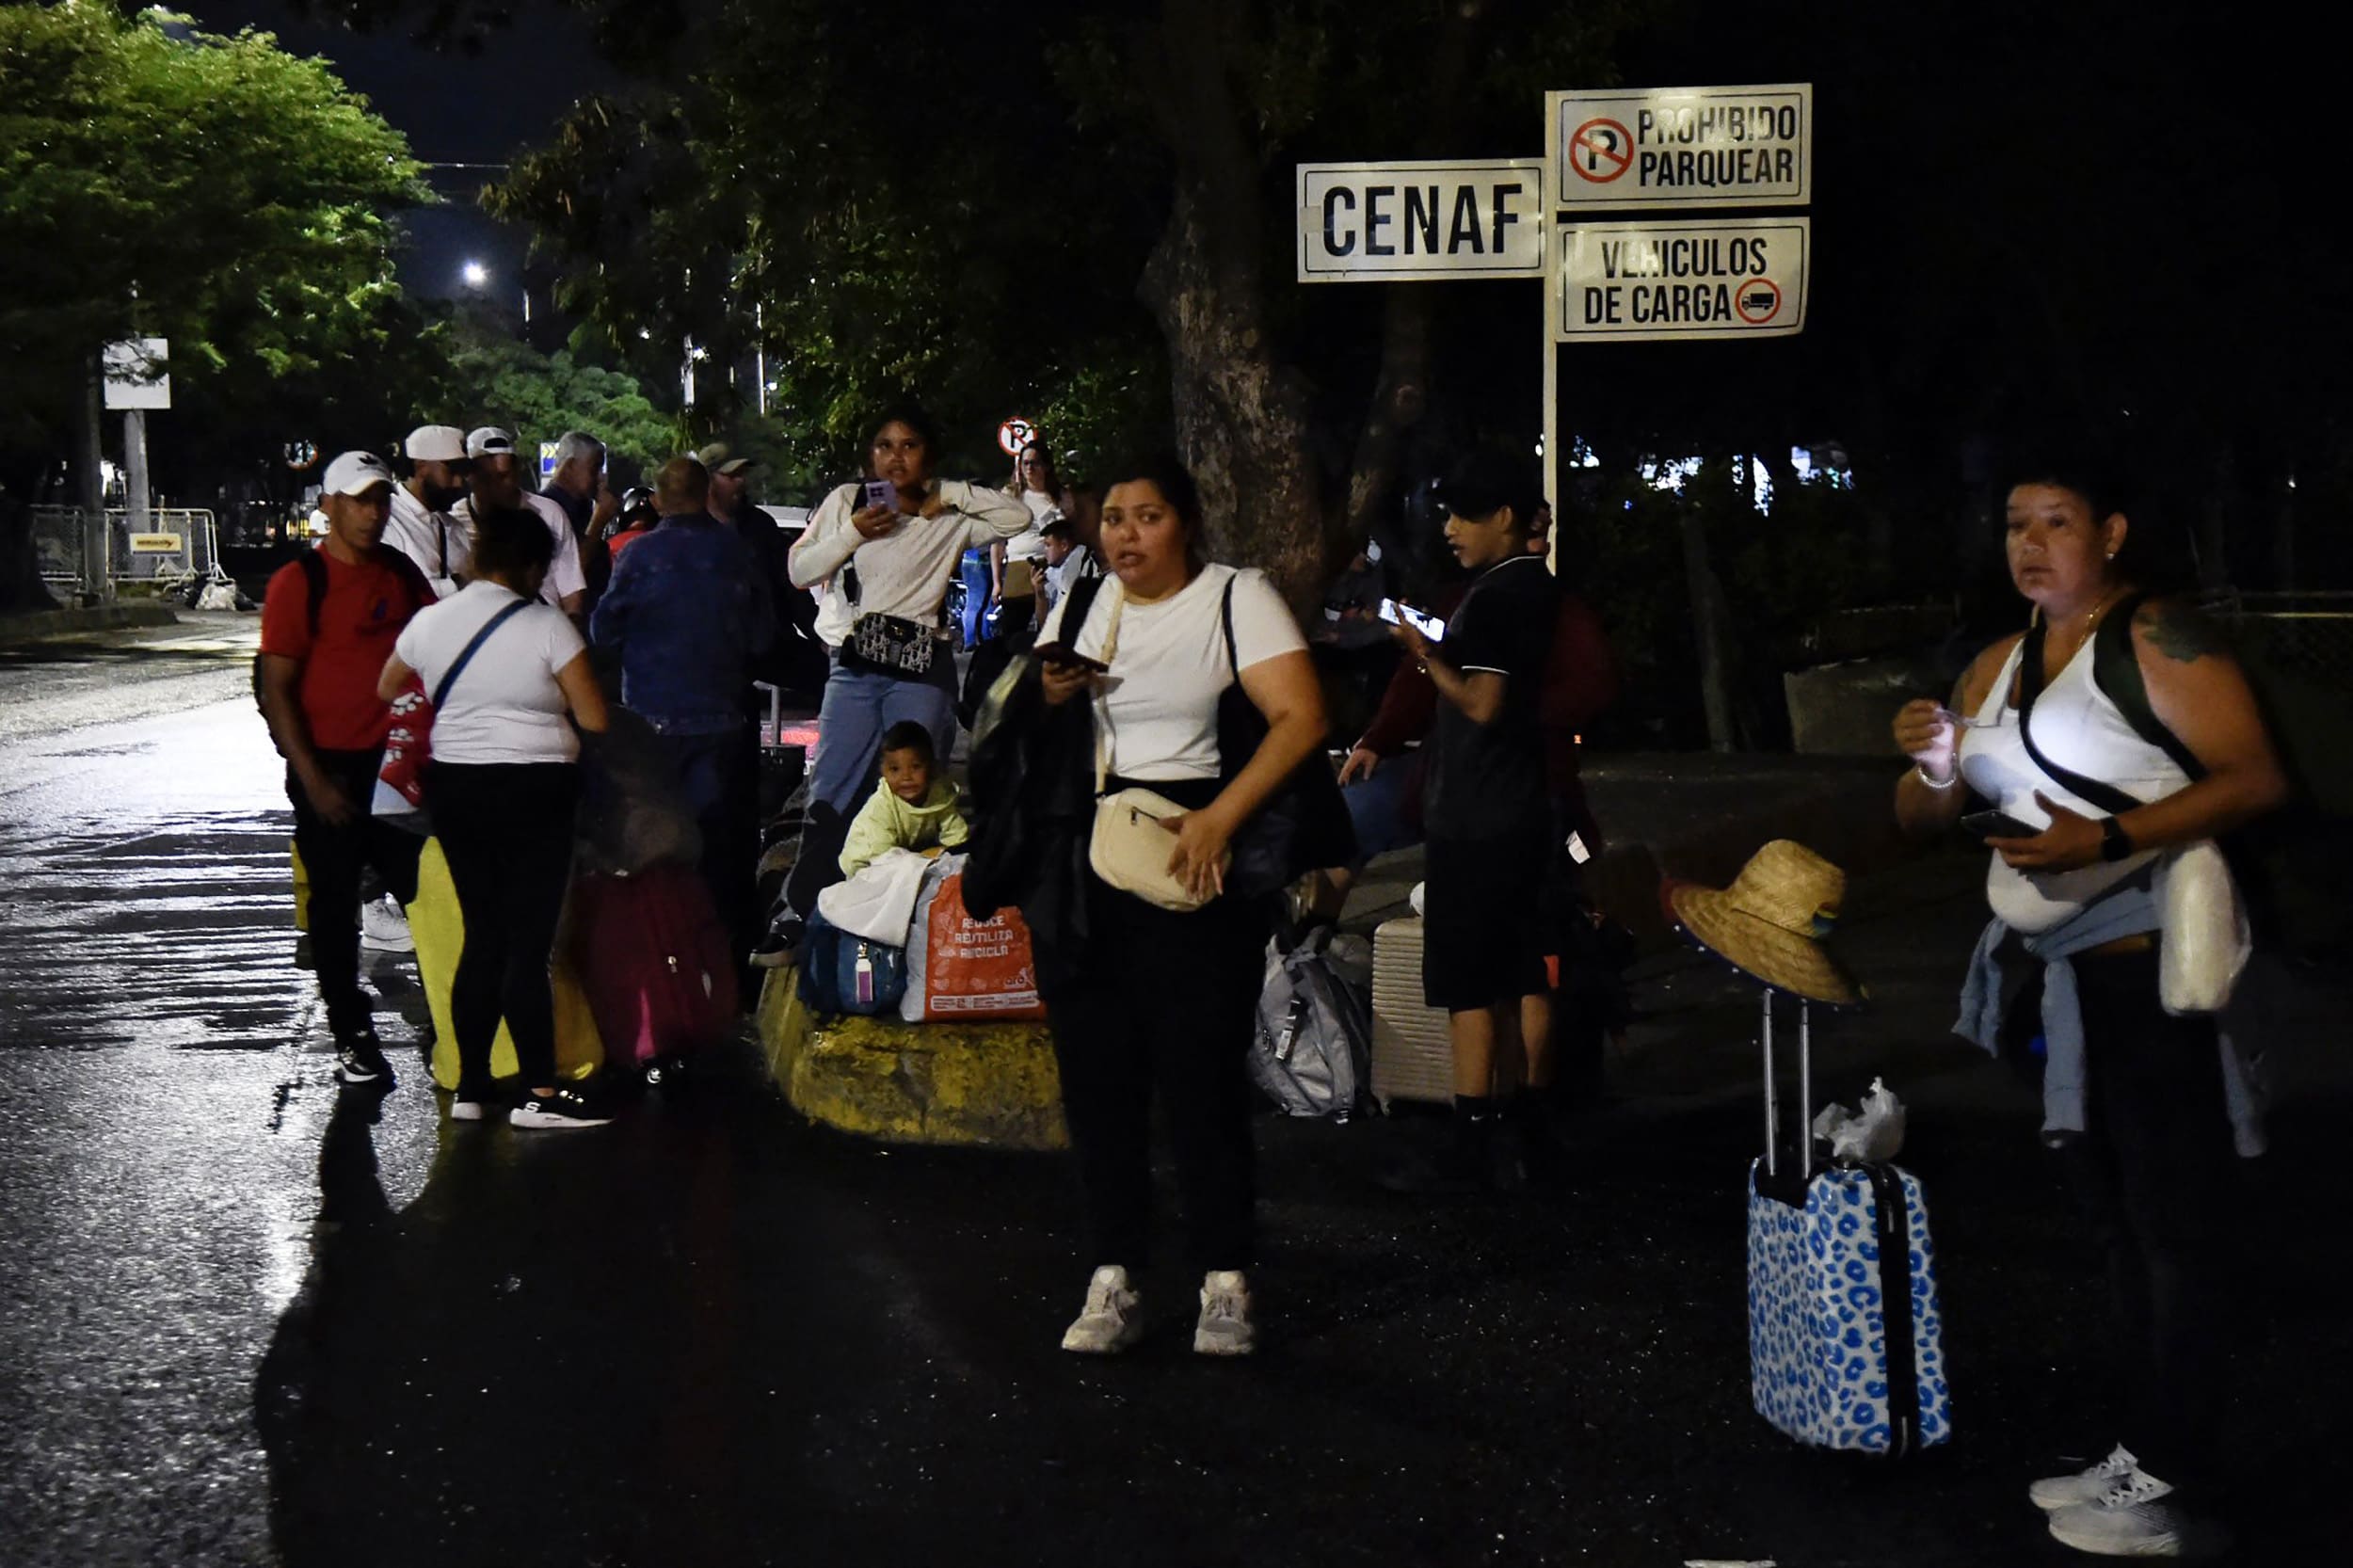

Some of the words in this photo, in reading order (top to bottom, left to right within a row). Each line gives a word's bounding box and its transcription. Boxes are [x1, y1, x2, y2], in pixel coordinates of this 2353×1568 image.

[1638, 104, 1796, 145] PROHIBIDO
[1639, 148, 1793, 187] PARQUEAR
[1322, 183, 1523, 257] CENAF
[1601, 237, 1768, 279] VEHICULOS
[1585, 285, 1623, 324] DE
[1632, 283, 1732, 323] CARGA
[954, 929, 1014, 943] REUTILIZA
